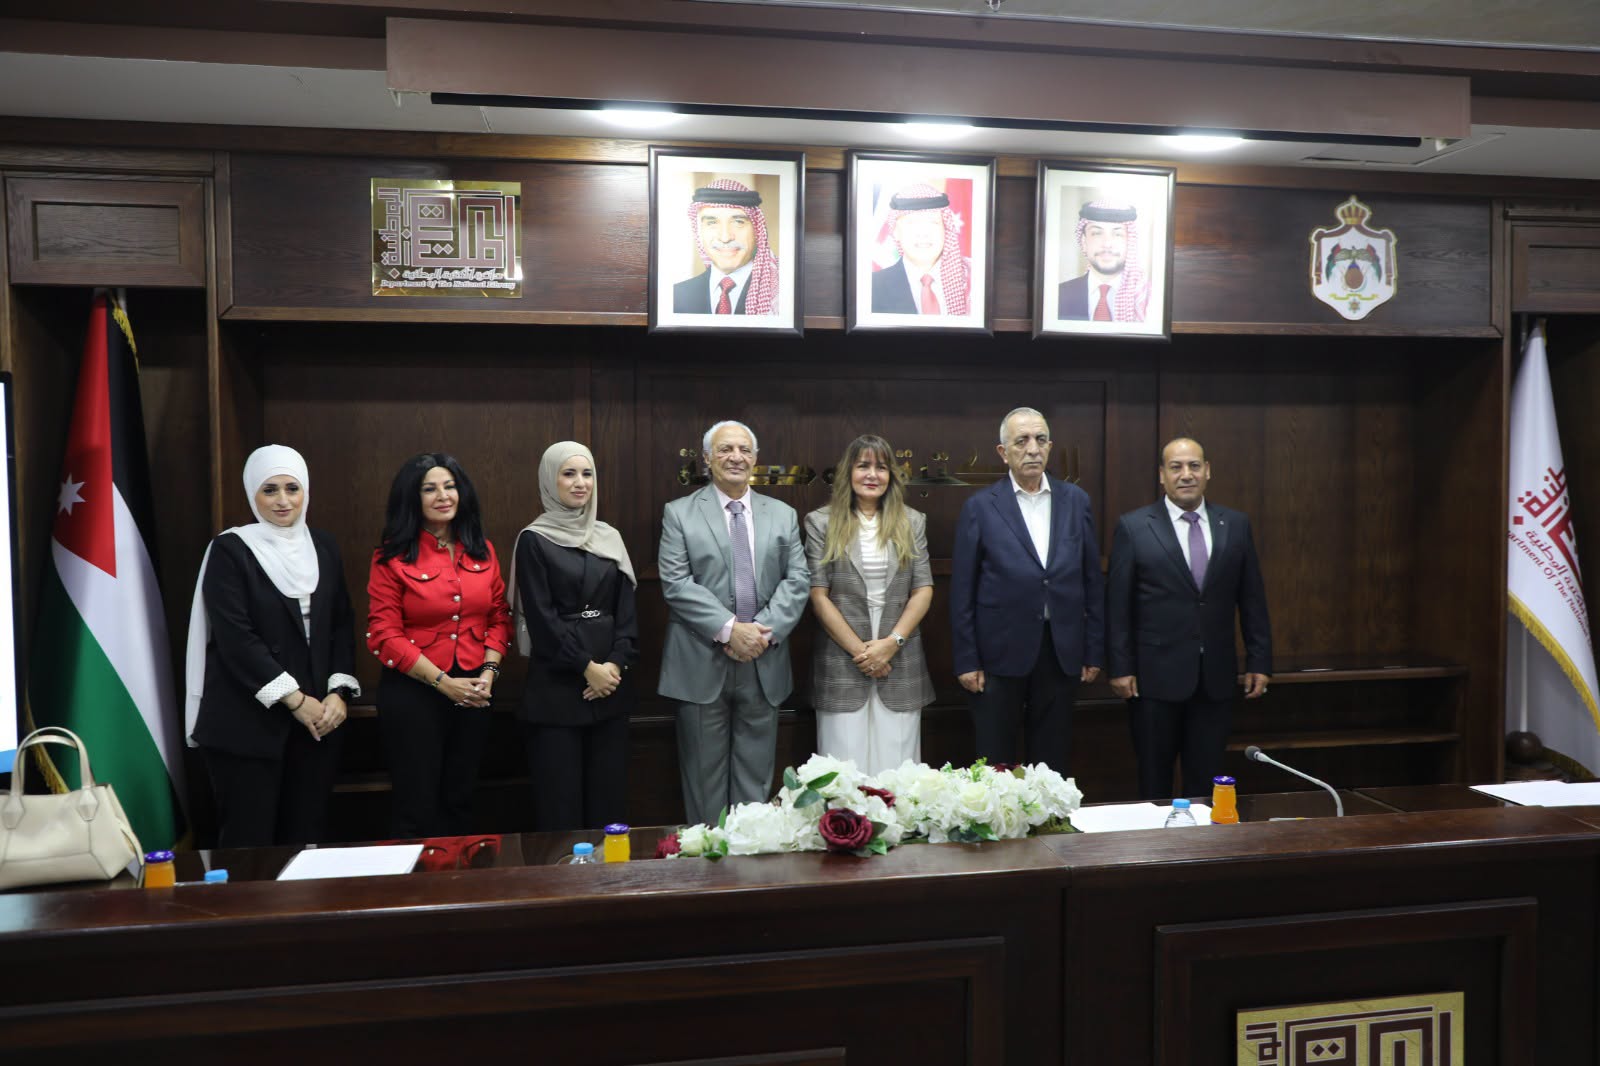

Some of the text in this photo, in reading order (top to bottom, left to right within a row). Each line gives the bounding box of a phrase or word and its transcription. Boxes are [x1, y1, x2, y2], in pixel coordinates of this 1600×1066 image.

[380, 279, 426, 288] Department
[453, 280, 487, 288] National
[487, 281, 516, 290] Library
[1508, 532, 1544, 568] artment
[1543, 567, 1557, 580] Of
[1555, 579, 1568, 598] The
[1525, 530, 1568, 575] الوطنية
